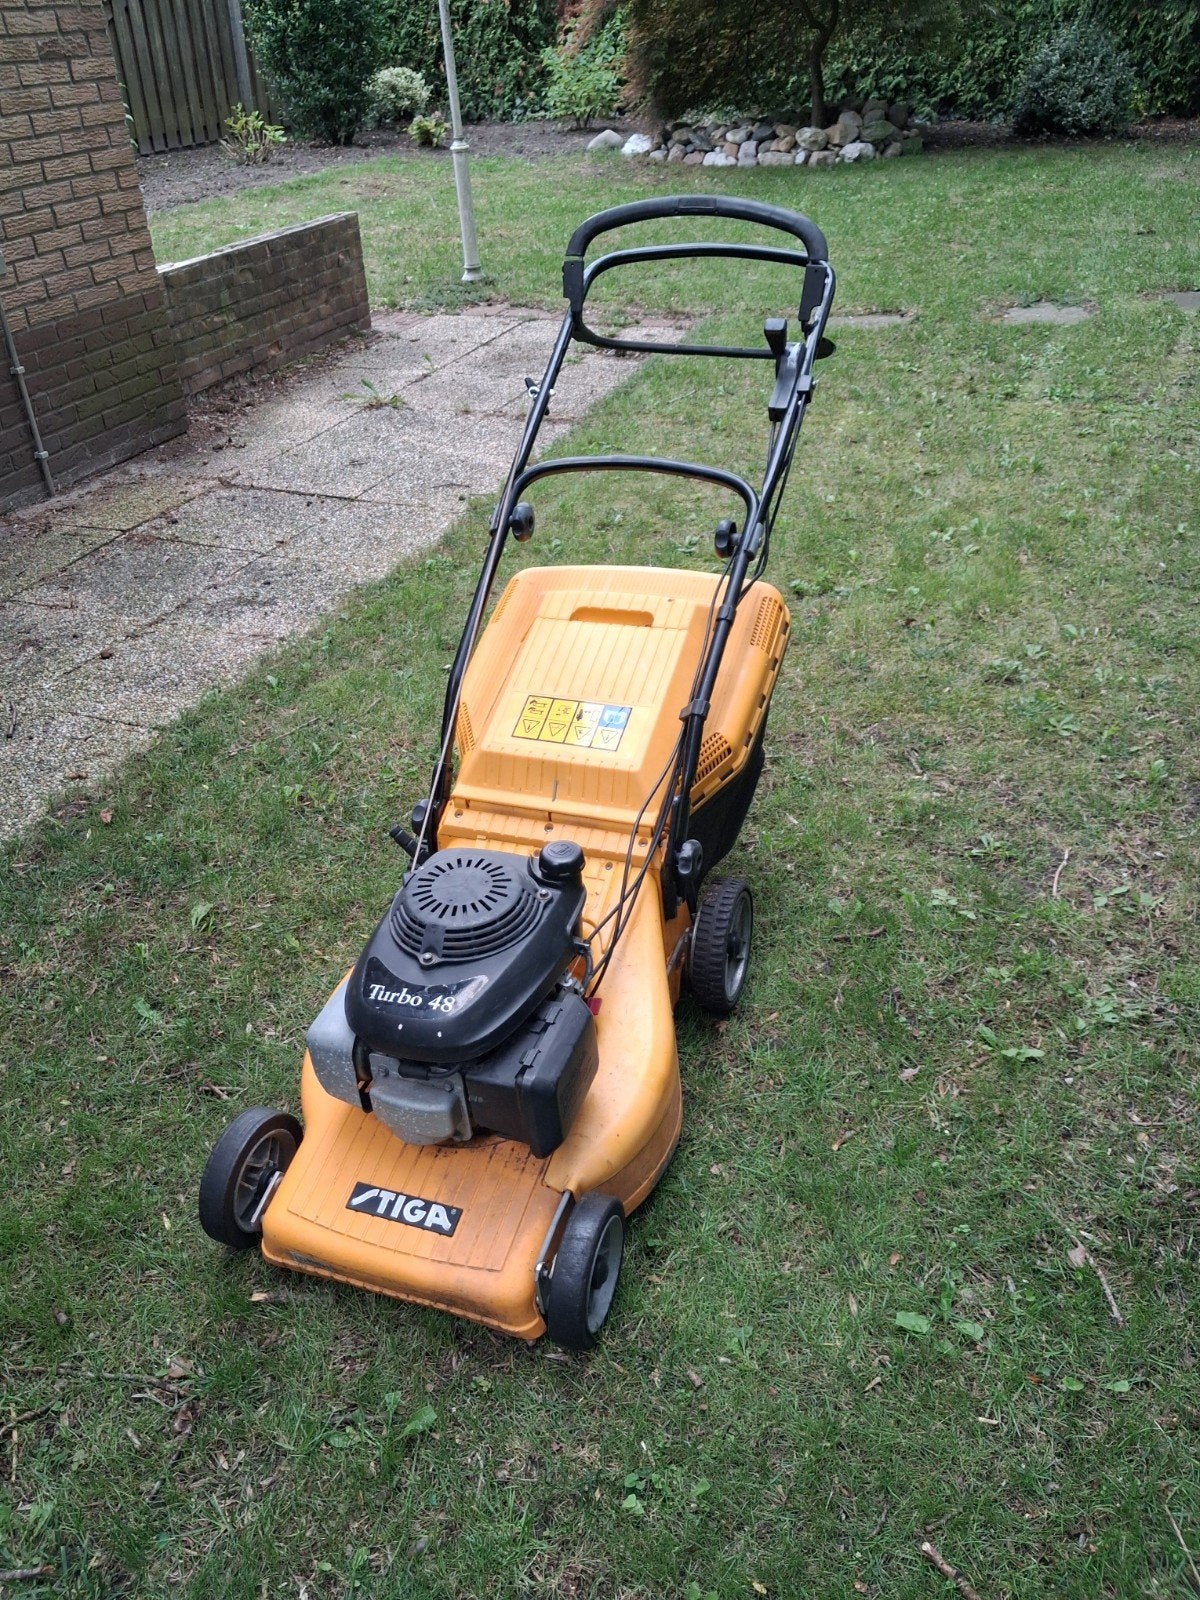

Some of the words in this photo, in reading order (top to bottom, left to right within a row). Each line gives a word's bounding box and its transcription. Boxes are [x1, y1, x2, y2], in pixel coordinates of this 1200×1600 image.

[369, 984, 423, 1006] Turbo
[428, 995, 456, 1012] 48
[351, 1189, 452, 1231] STIGA
